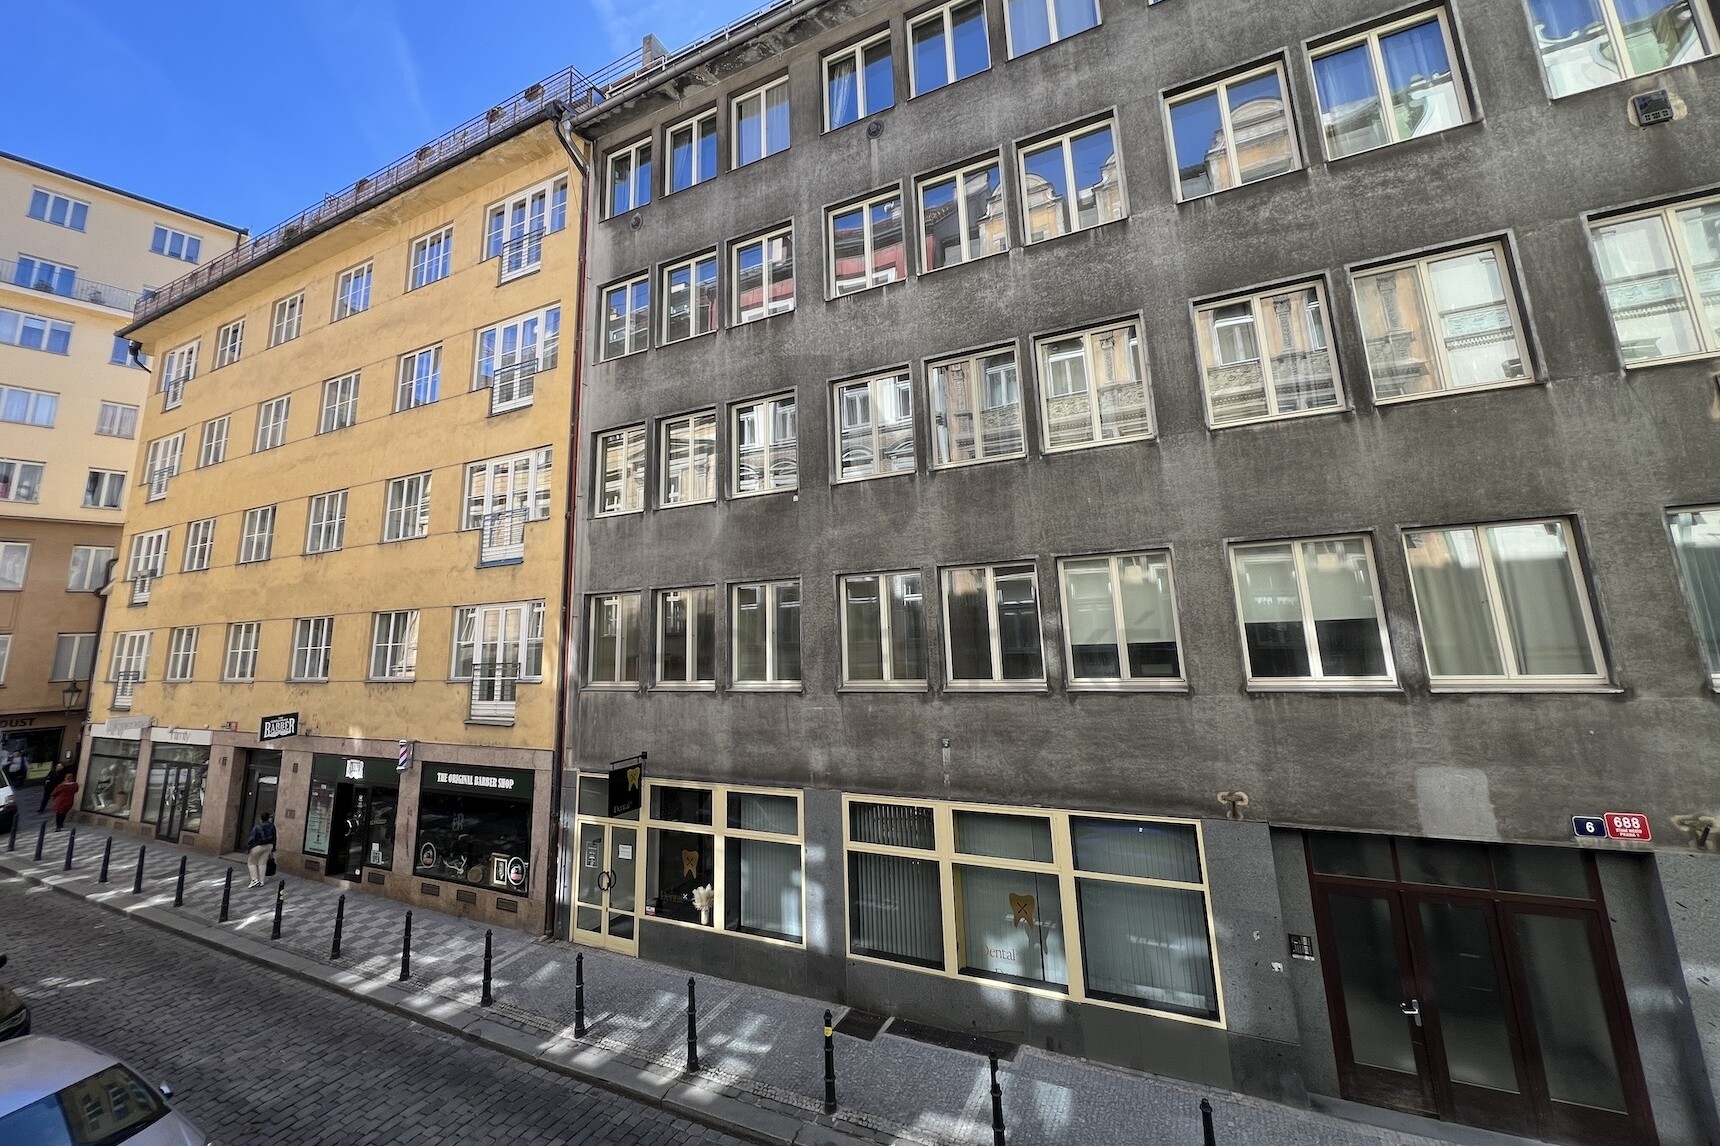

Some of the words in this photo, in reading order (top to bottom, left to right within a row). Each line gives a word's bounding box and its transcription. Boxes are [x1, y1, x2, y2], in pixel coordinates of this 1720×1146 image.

[264, 718, 295, 738] BARBER
[437, 772, 448, 782] THE
[448, 774, 473, 785] ORIGINAL
[474, 776, 497, 788] BARBER
[498, 778, 514, 790] SHOP
[1586, 822, 1594, 832] 6
[1614, 816, 1640, 828] 688
